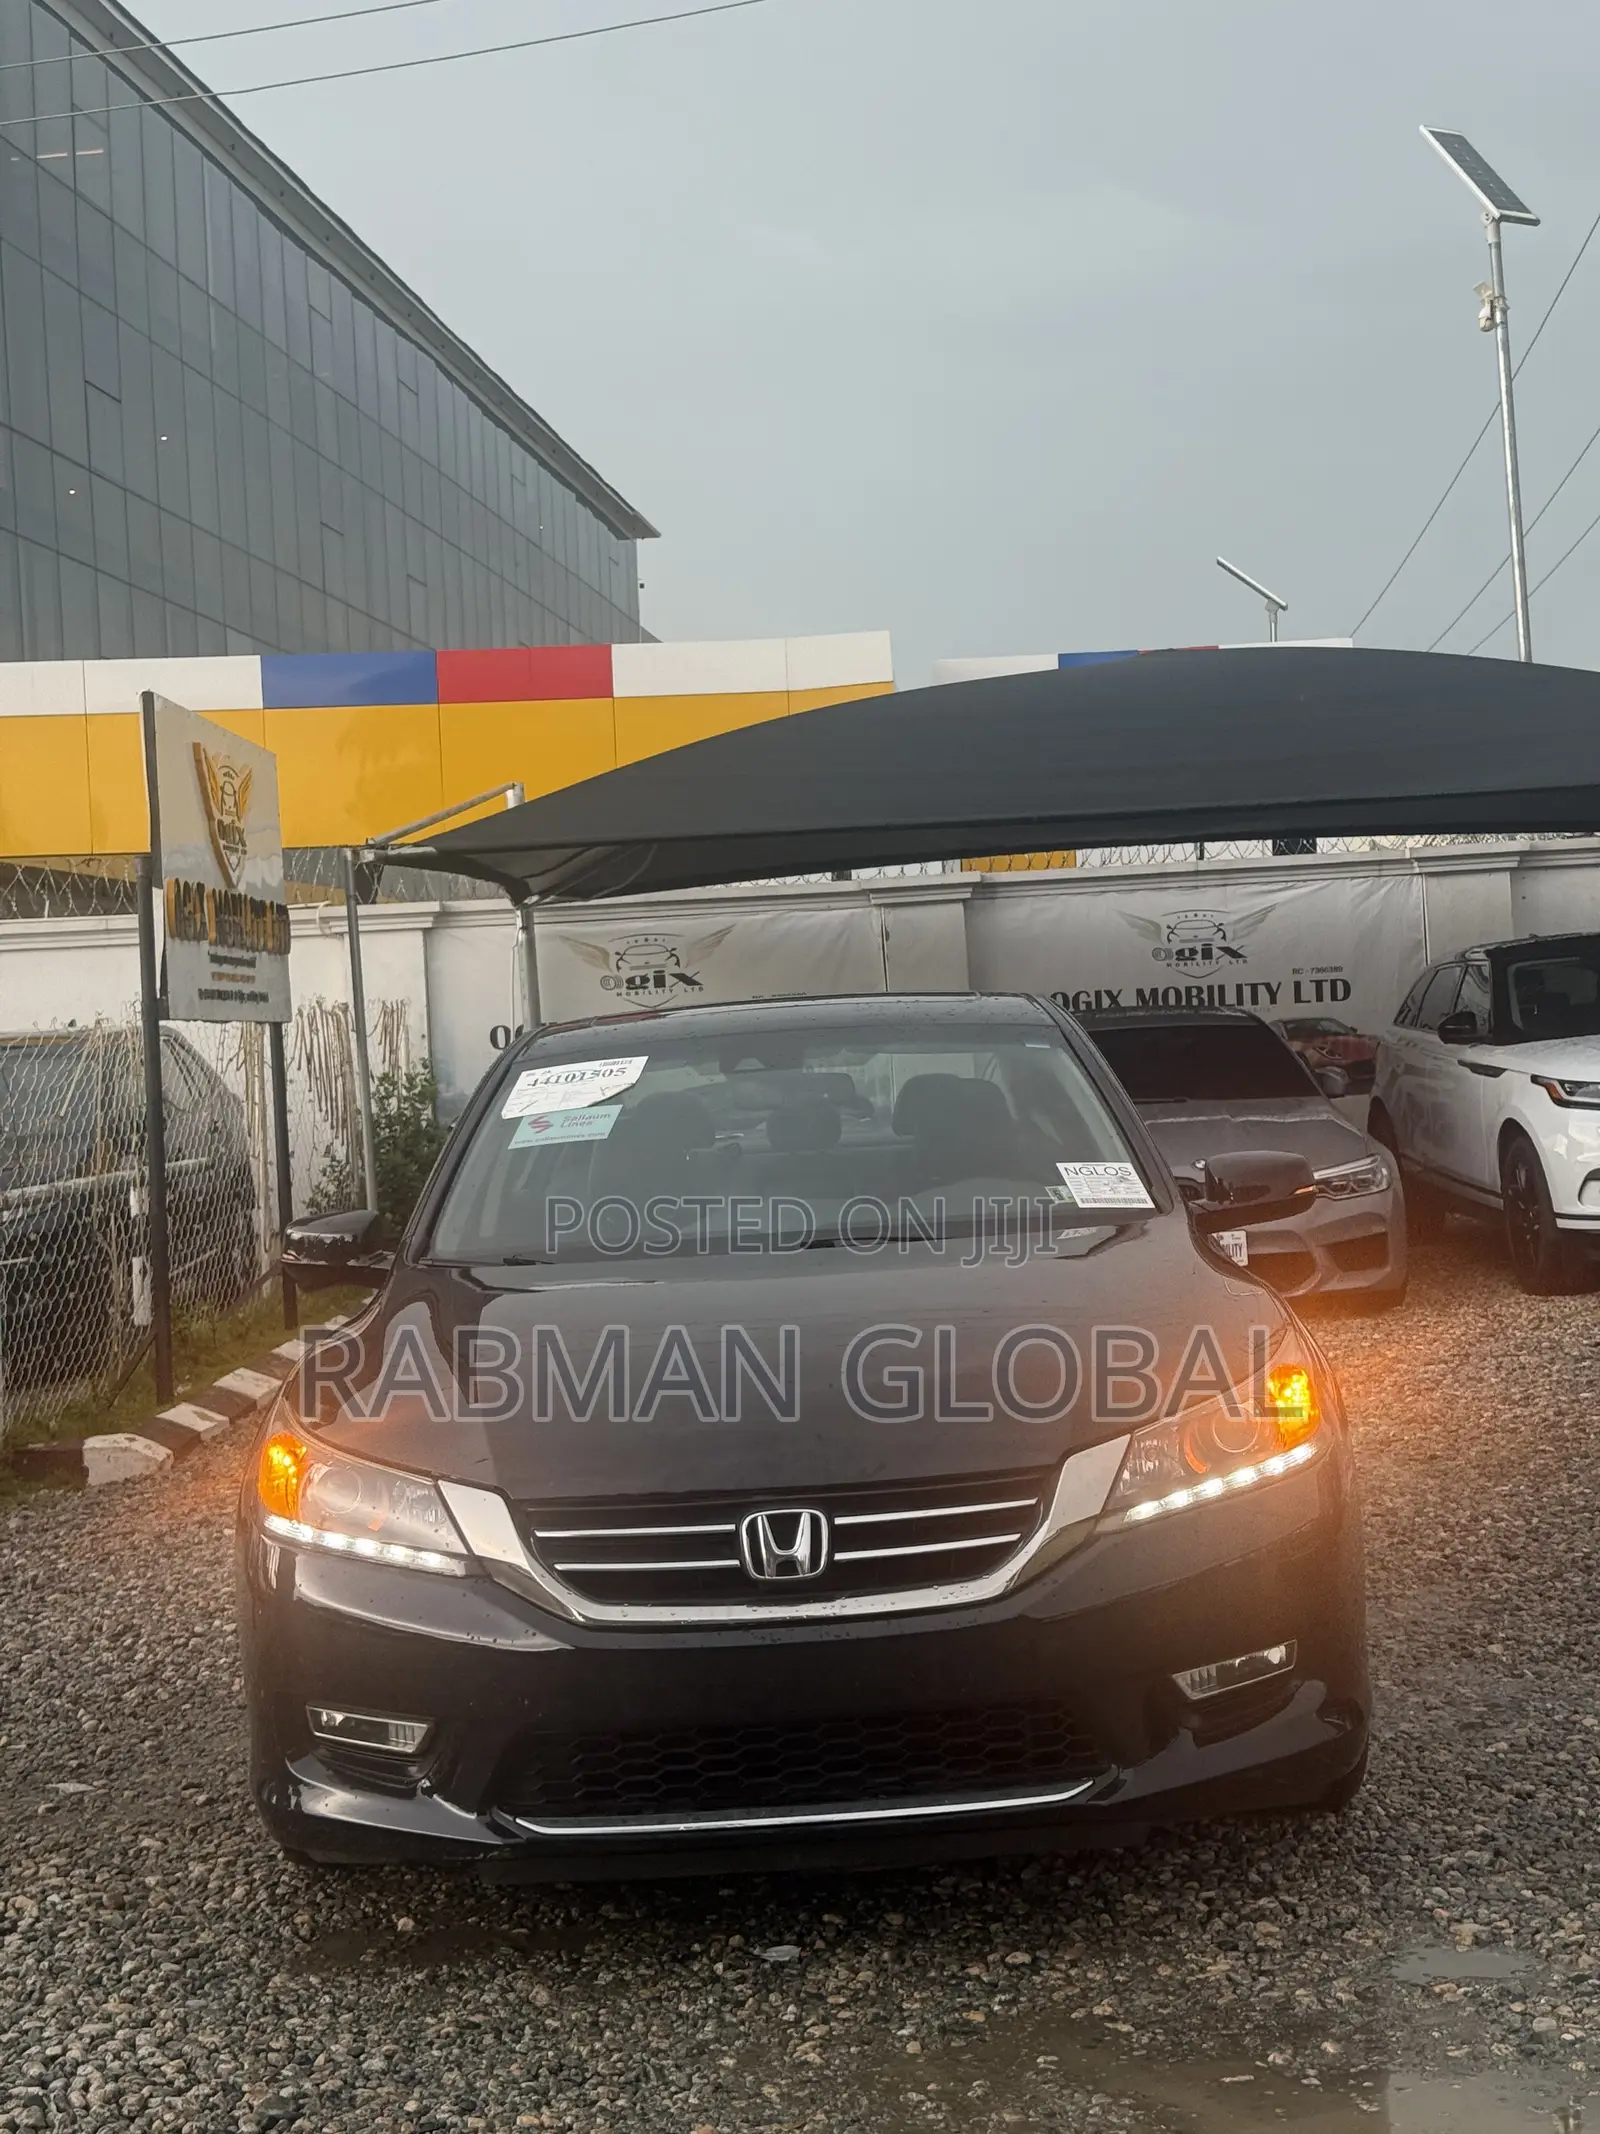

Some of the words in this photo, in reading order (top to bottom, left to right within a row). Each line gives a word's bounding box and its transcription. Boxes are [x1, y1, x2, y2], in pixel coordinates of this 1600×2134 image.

[616, 988, 674, 997] MOBILITY
[1050, 989, 1122, 1012] OGIX
[1136, 981, 1281, 1008] MOBILITY
[1293, 978, 1351, 1004] LTD
[1064, 1166, 1132, 1177] NGLOS
